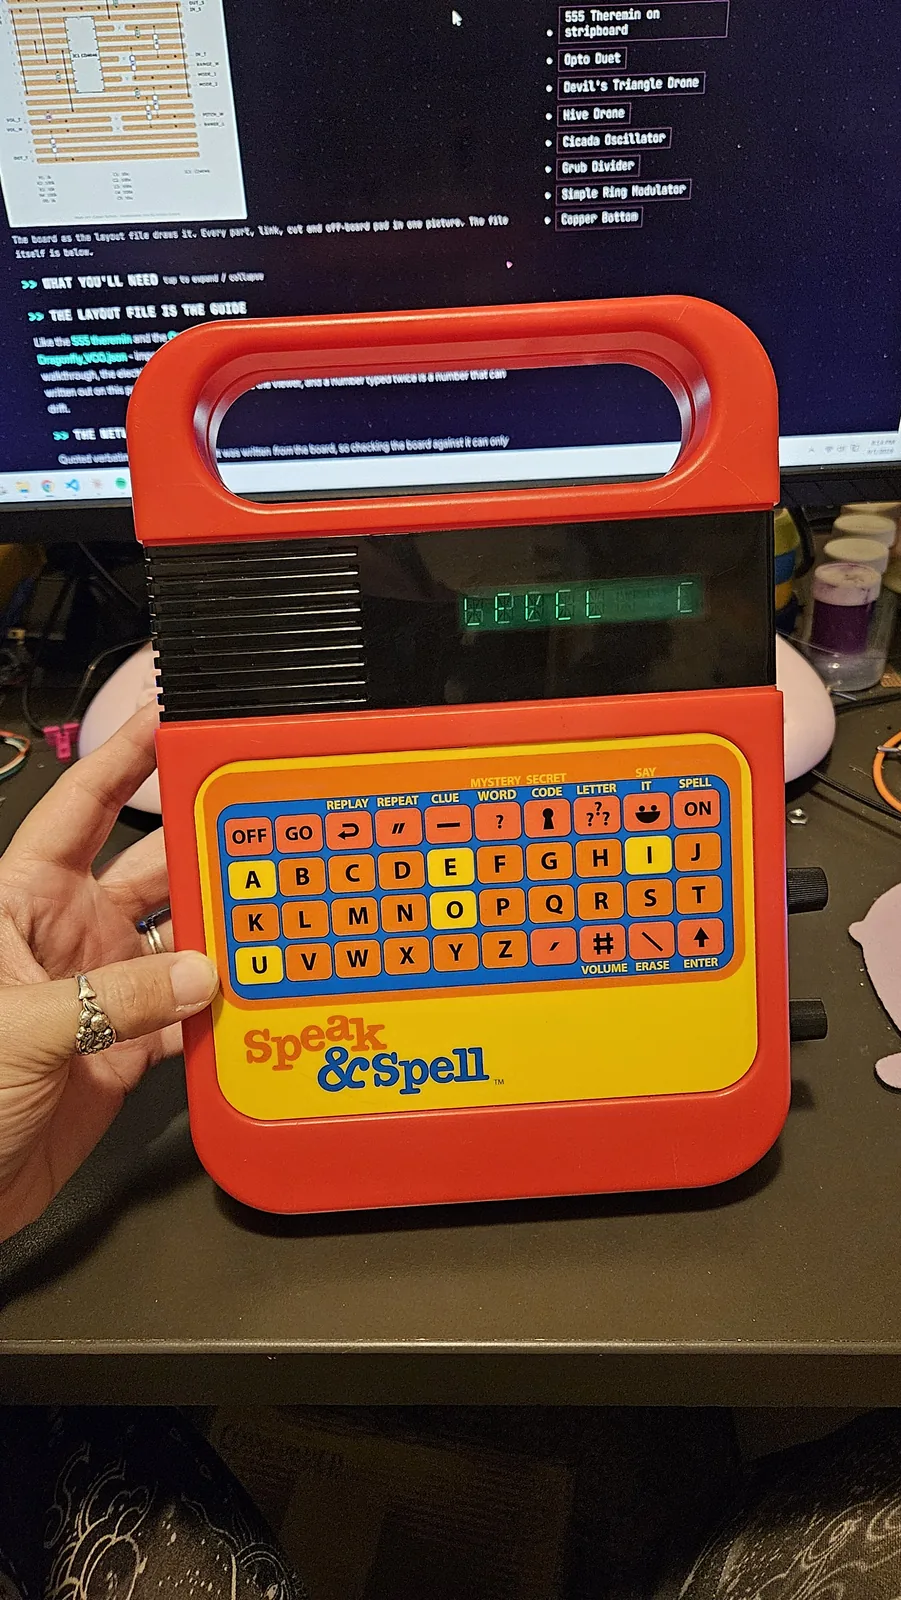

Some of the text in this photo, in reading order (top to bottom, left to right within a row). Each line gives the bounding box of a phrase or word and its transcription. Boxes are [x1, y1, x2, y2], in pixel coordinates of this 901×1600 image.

[564, 8, 661, 23] 555 Theremin on
[564, 24, 629, 39] stripboard
[564, 52, 622, 67] Opto Duet
[563, 76, 700, 94] Devil's Triangle Drone
[563, 107, 626, 121] Hive Drone
[562, 132, 667, 148] Cicada Oscillator
[561, 159, 636, 174] Grub Divider
[561, 183, 687, 201] Simple Ring Modulator
[561, 210, 639, 227] Copper Bottom
[11, 235, 29, 245] The
[75, 233, 92, 242] the
[94, 231, 126, 243] layout
[128, 230, 150, 241] file
[200, 227, 227, 239] Every
[258, 225, 284, 237] link,
[306, 223, 323, 234] and
[325, 221, 371, 233] off-board
[392, 219, 405, 231] in
[407, 220, 424, 230] one
[468, 215, 486, 227] The
[488, 214, 510, 227] file
[15, 248, 46, 259] itself
[49, 248, 61, 258] is
[41, 276, 73, 290] WHAT
[77, 275, 124, 289] YOU'LL
[127, 273, 159, 287] NEED
[179, 275, 190, 285] to
[228, 272, 265, 284] collapse
[48, 300, 248, 322] THE LAYOUT FILE IS THE GUIDE
[33, 336, 55, 348] Like
[54, 336, 72, 347] the
[70, 334, 91, 347] 555
[90, 333, 133, 346] theremin
[132, 333, 152, 344] and
[151, 332, 168, 343] the
[99, 367, 116, 380] the
[44, 386, 78, 398] written
[77, 386, 94, 397] out
[93, 386, 107, 397] on
[105, 384, 125, 396] this
[427, 372, 435, 382] a
[434, 370, 470, 382] number
[469, 369, 489, 380] that
[488, 368, 507, 379] can
[72, 427, 97, 440] THE
[57, 453, 93, 465] Quoted
[272, 443, 294, 457] from
[293, 443, 309, 456] the
[337, 442, 351, 454] so
[350, 440, 390, 454] checking
[390, 439, 406, 452] the
[405, 437, 433, 451] board
[432, 436, 465, 451] against
[464, 435, 472, 448] it
[471, 436, 489, 448] can
[489, 434, 510, 448] only
[526, 773, 567, 785] SECRET
[635, 767, 657, 778] SAY
[470, 776, 521, 788] MYSTERY
[576, 783, 617, 796] LETTER
[641, 780, 652, 792] IT
[679, 777, 712, 789] SPELL
[431, 793, 460, 804] CLUE
[477, 789, 517, 802] WORD
[531, 786, 563, 798] CODE
[326, 799, 369, 811] REPLAY
[376, 795, 419, 807] REPEAT
[684, 801, 712, 817] ON
[232, 828, 267, 845] OFF
[285, 825, 313, 842] GO
[245, 843, 701, 889] A B C D E F G H I J
[249, 885, 706, 932] K L M N O P Q R S T
[251, 940, 513, 974] U V W X Y Z
[683, 957, 719, 969] ENTER
[581, 963, 628, 975] VOLUME
[635, 960, 670, 972] ERASE
[243, 1014, 388, 1072] Speak
[372, 1047, 490, 1095] Spell
